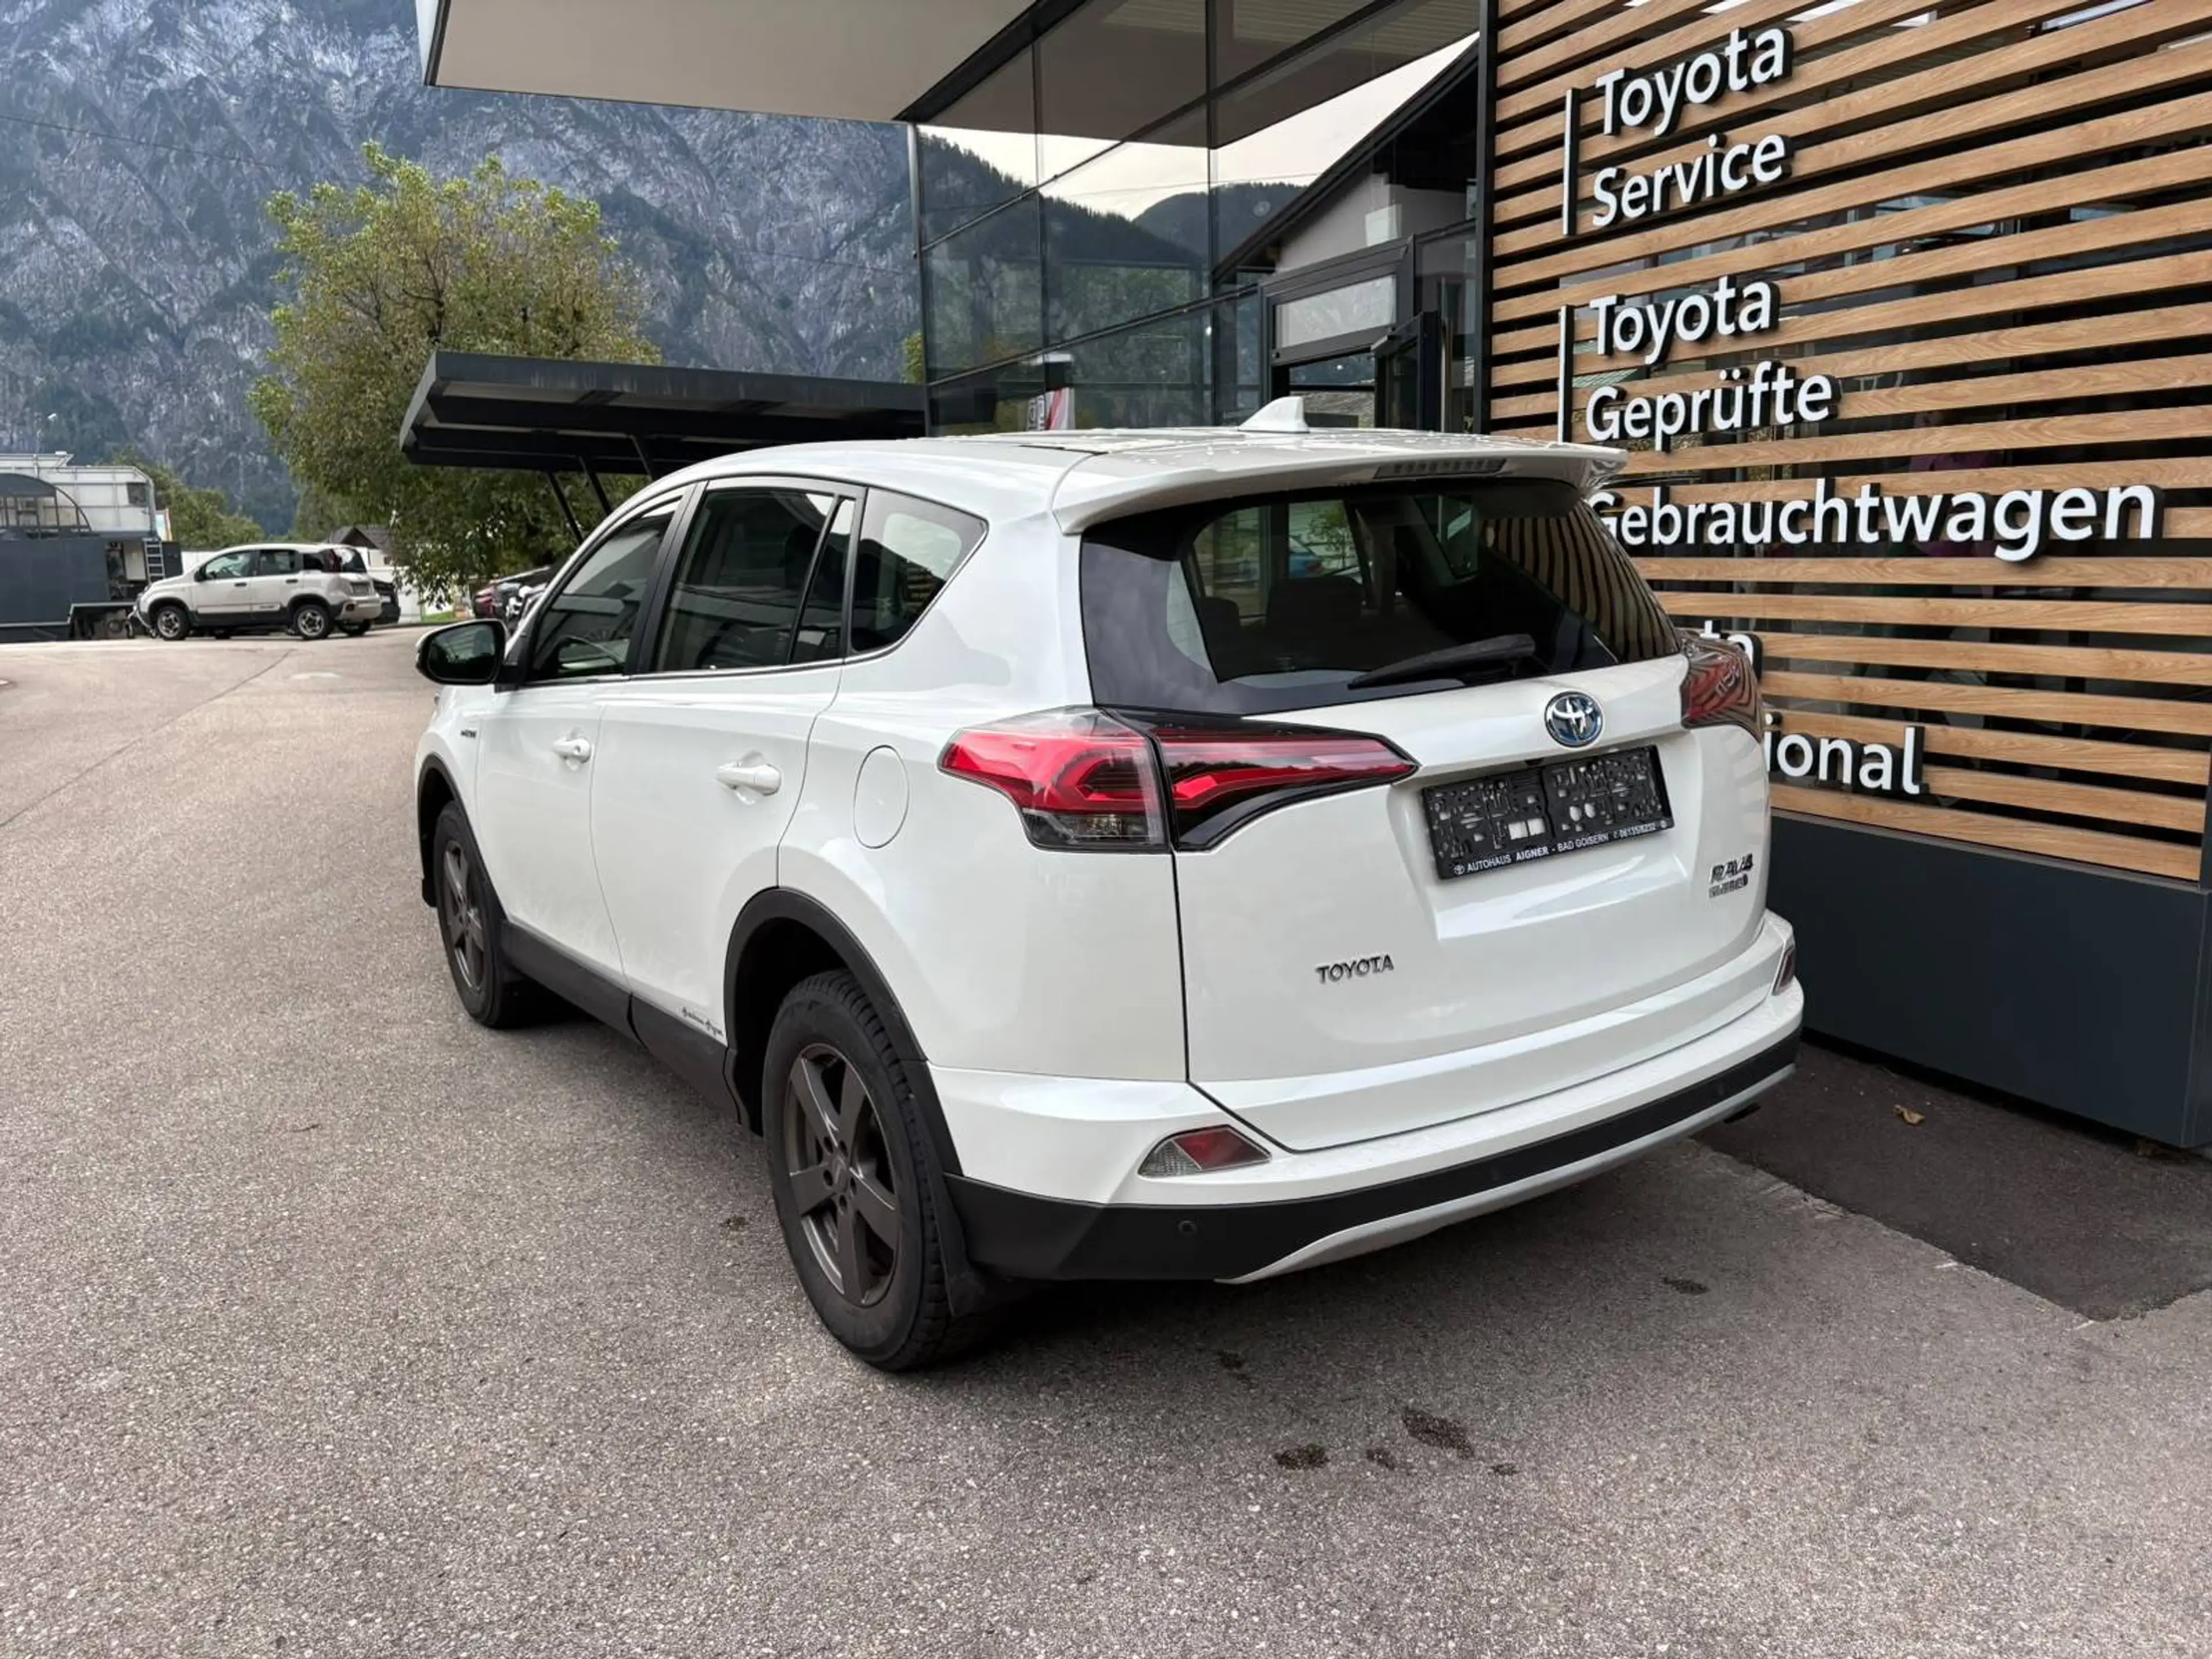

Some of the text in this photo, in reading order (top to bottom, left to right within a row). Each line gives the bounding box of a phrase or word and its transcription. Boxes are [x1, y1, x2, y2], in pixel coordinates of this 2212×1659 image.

[1594, 28, 1785, 137] Toyota
[1592, 133, 1786, 228] Service
[1589, 275, 1772, 365] Toyota
[1585, 361, 1832, 452] Geprüfte
[1587, 478, 2155, 561] Gebrauchtwagen
[1763, 713, 1920, 794] ional
[1467, 854, 1512, 873] AUTOHAUS
[1516, 845, 1550, 862] AIGNER
[1557, 840, 1574, 853] BAD
[1315, 954, 1395, 984] TOYOTA
